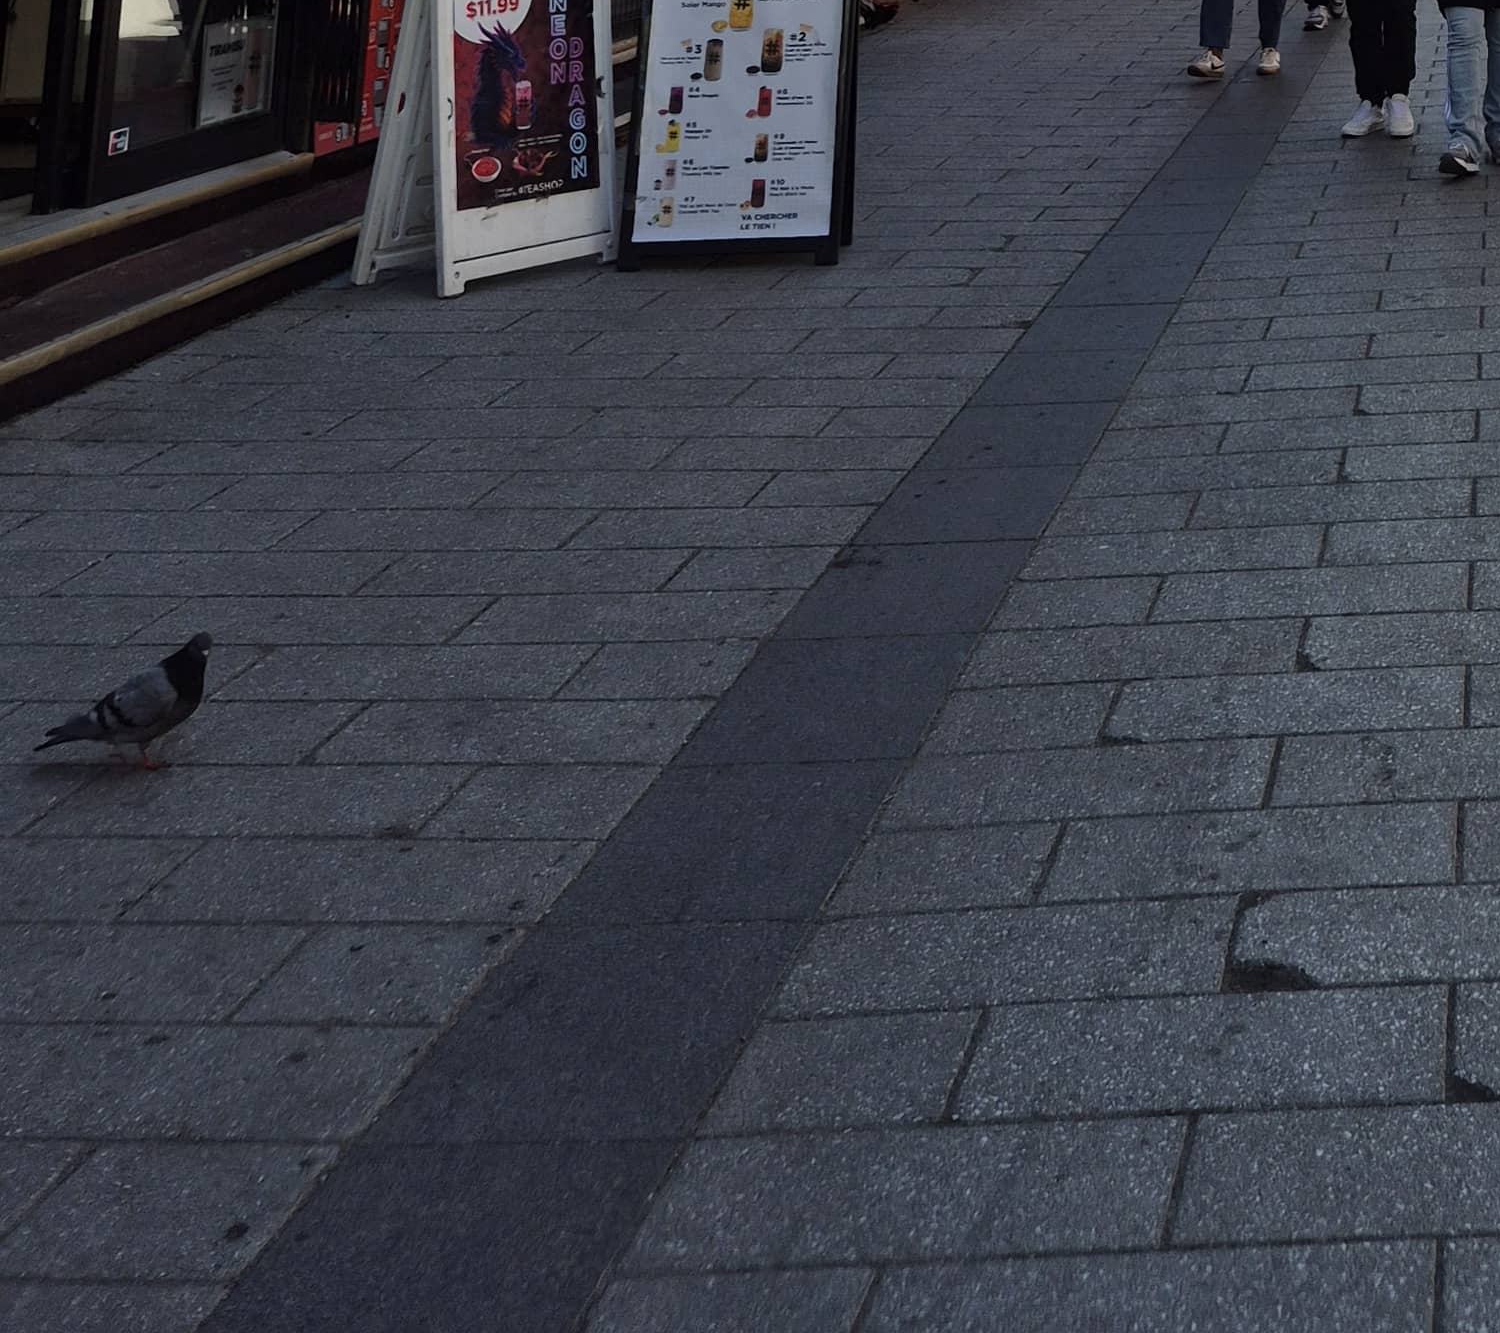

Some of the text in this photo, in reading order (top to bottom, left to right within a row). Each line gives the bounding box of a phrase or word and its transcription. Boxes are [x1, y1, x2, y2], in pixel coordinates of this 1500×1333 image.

[789, 31, 807, 42] #2
[686, 44, 702, 55] #3
[568, 36, 588, 180] DRAGON
[740, 212, 798, 221] VA CHERCHER
[739, 223, 752, 231] LE
[752, 222, 771, 230] TIEN
